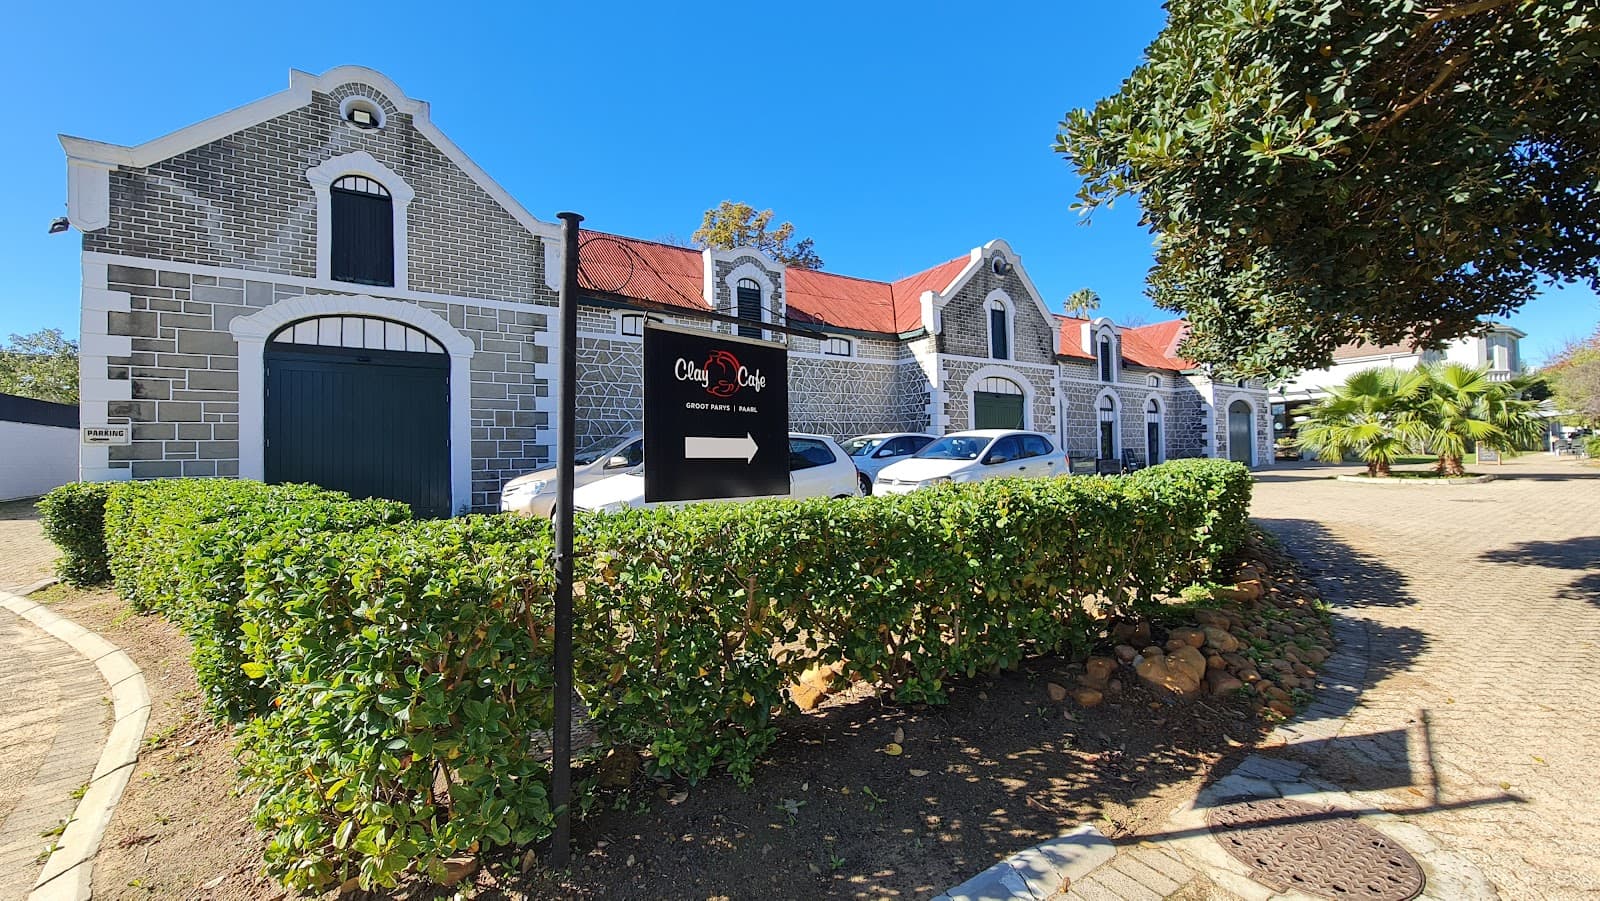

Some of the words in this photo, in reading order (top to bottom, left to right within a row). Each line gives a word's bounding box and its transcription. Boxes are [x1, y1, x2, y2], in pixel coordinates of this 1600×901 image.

[675, 357, 709, 388] Clay
[737, 365, 766, 393] Cafe
[686, 402, 709, 410] GROOT
[710, 403, 731, 412] PARYS
[738, 405, 758, 413] PAARL
